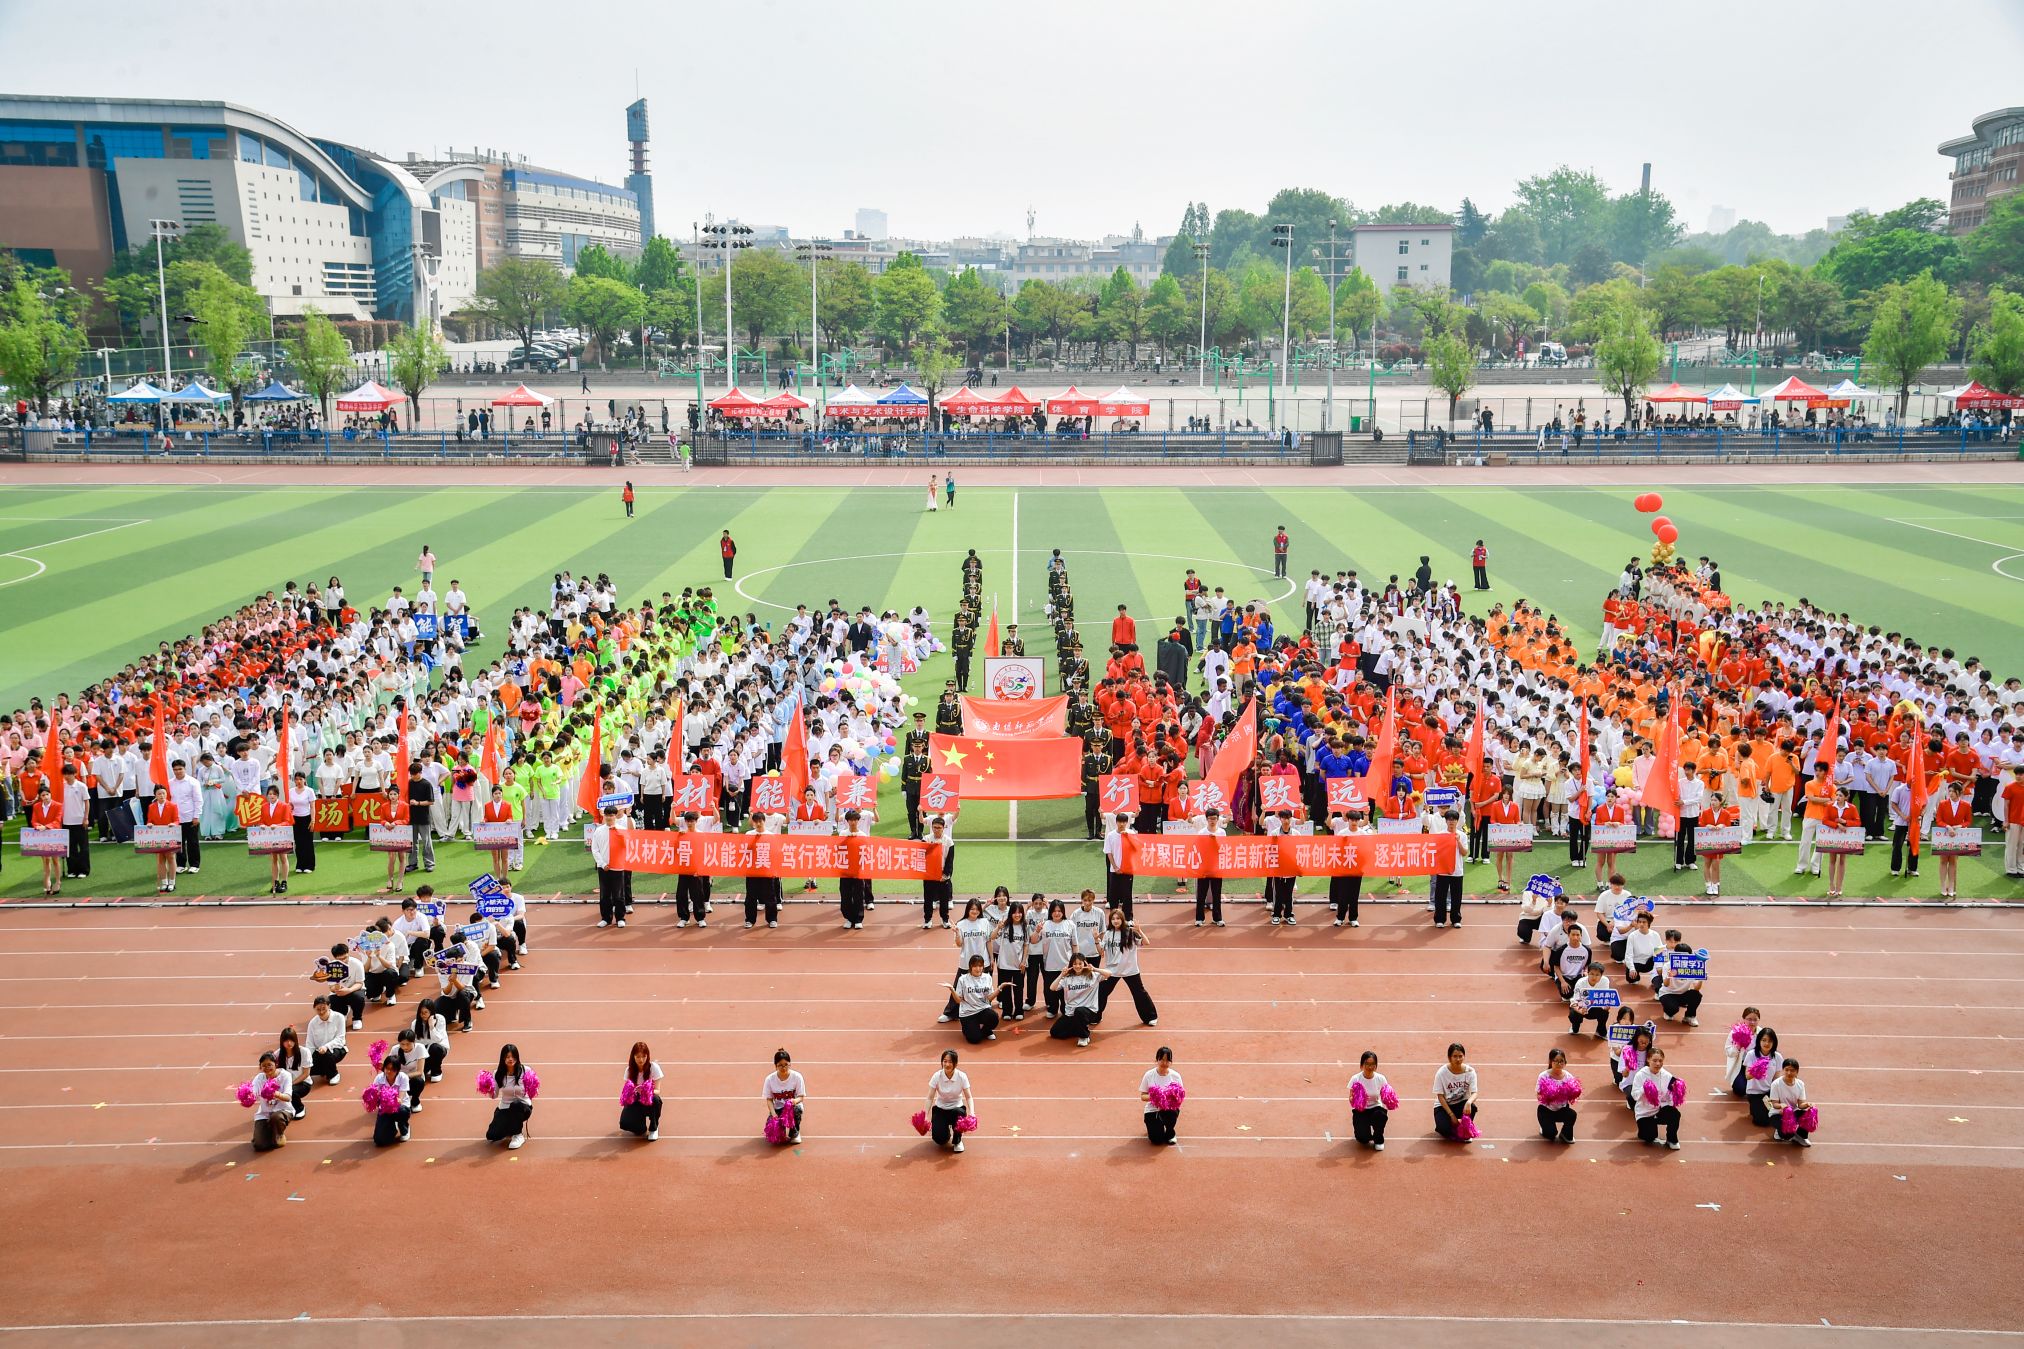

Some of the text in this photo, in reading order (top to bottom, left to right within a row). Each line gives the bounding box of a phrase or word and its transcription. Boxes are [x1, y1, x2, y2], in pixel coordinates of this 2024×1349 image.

[828, 407, 928, 415] 美术与艺术设计学院
[956, 405, 1025, 414] 生命科学学院
[1052, 405, 1143, 415] 体育学院
[676, 778, 711, 809] 材
[754, 778, 786, 809] 能
[838, 777, 873, 806] 兼
[921, 776, 959, 809] 备
[1103, 776, 1135, 812] 行
[1191, 782, 1228, 812] 稳
[1262, 776, 1300, 809] 致
[1329, 779, 1369, 809] 远
[238, 796, 264, 824] 修
[318, 802, 344, 828] 场
[358, 800, 381, 821] 化
[625, 839, 927, 873] 以材为骨 以能为翼 笃行致远 科创无疆
[1140, 842, 1437, 870] 材聚匠心 能启新程 研创未来 逐光而行
